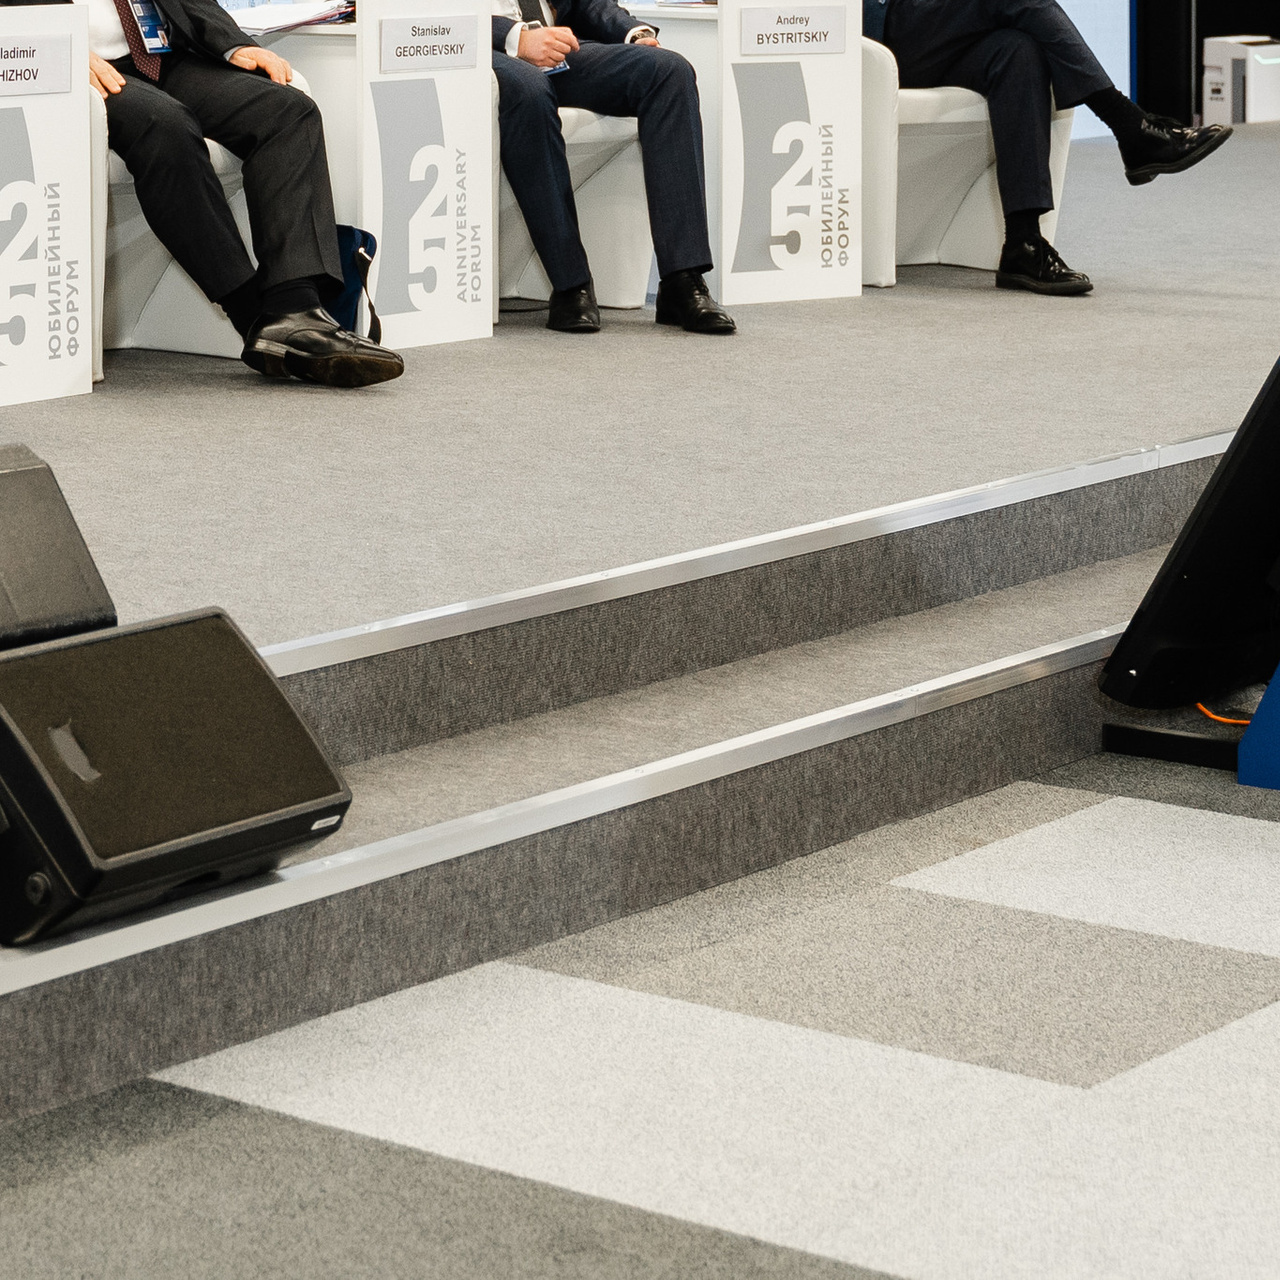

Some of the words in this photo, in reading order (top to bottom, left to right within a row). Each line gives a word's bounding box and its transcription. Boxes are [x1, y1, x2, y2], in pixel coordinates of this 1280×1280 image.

[395, 43, 465, 58] GEORGIEVSKIY
[410, 25, 451, 38] Stanislav
[756, 31, 829, 45] BYSTRITSKIY
[776, 15, 810, 28] Andrey
[455, 148, 468, 303] ANNIVERSARY
[818, 124, 834, 269] ЮБИЛЕЙНЫЙ
[837, 187, 850, 267] ФОРУМ
[44, 182, 60, 360] ЮБИЛЕЙНЫЙ
[471, 224, 482, 303] FORUM
[66, 259, 80, 357] ФОРУМ
